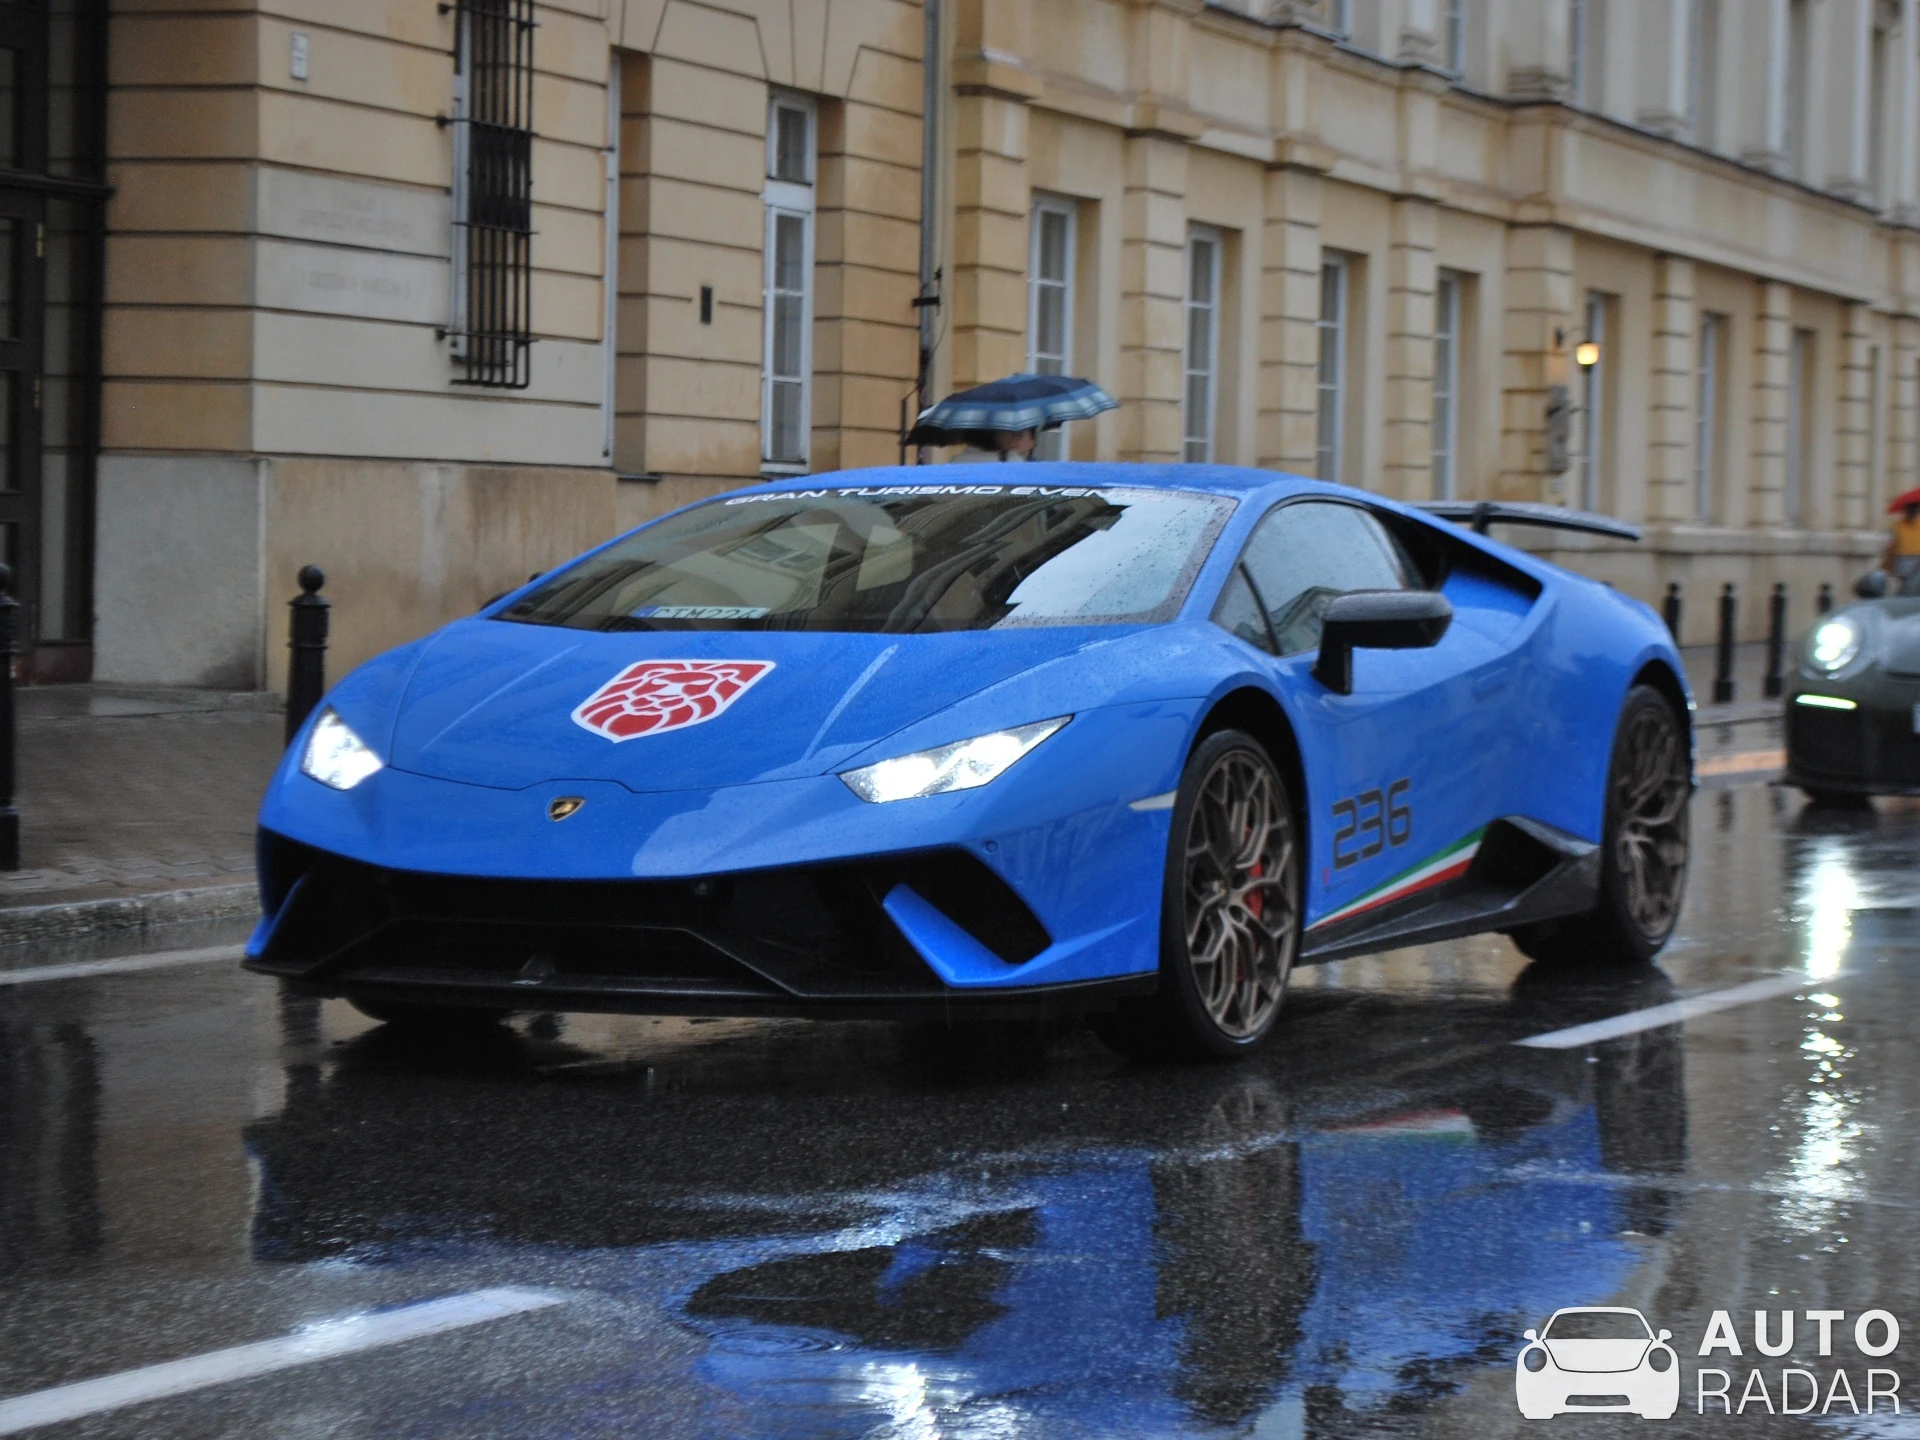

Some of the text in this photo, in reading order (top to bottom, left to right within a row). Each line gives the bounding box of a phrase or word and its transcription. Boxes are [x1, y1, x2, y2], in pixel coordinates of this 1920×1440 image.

[725, 489, 828, 505] GRAN
[837, 485, 1004, 497] TURISMO
[1331, 777, 1412, 870] 236
